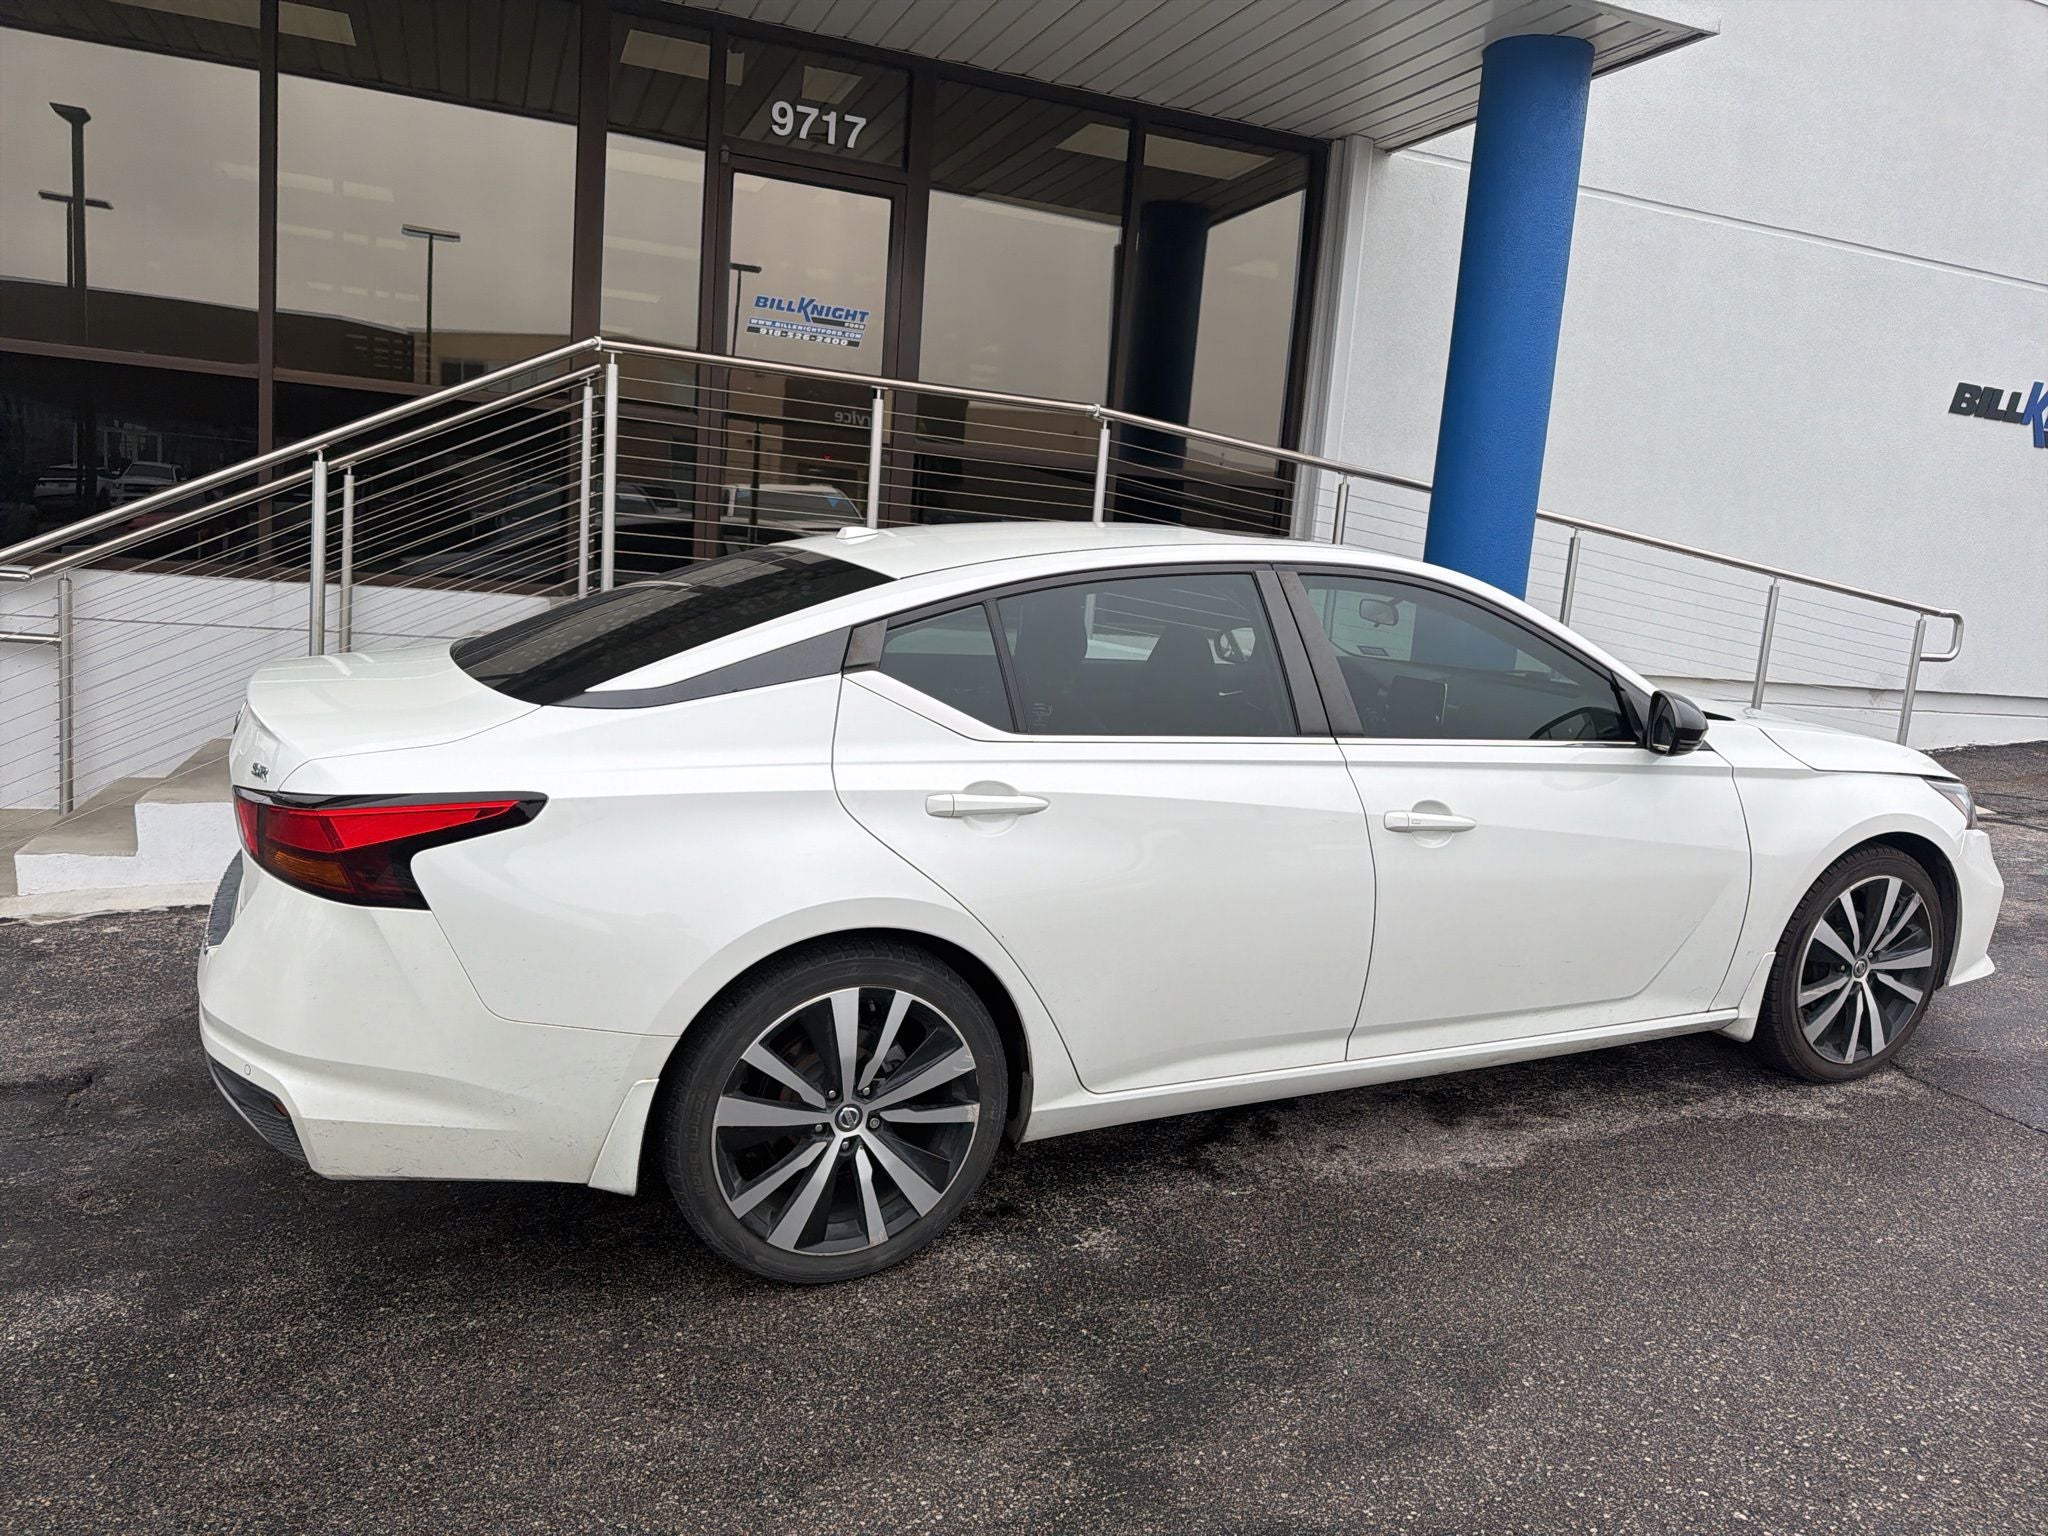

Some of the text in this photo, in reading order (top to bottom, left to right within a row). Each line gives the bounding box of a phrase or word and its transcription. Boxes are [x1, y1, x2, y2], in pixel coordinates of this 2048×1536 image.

[771, 101, 867, 149] 9717
[844, 322, 865, 330] FORD
[759, 328, 849, 346] 918-526-2400
